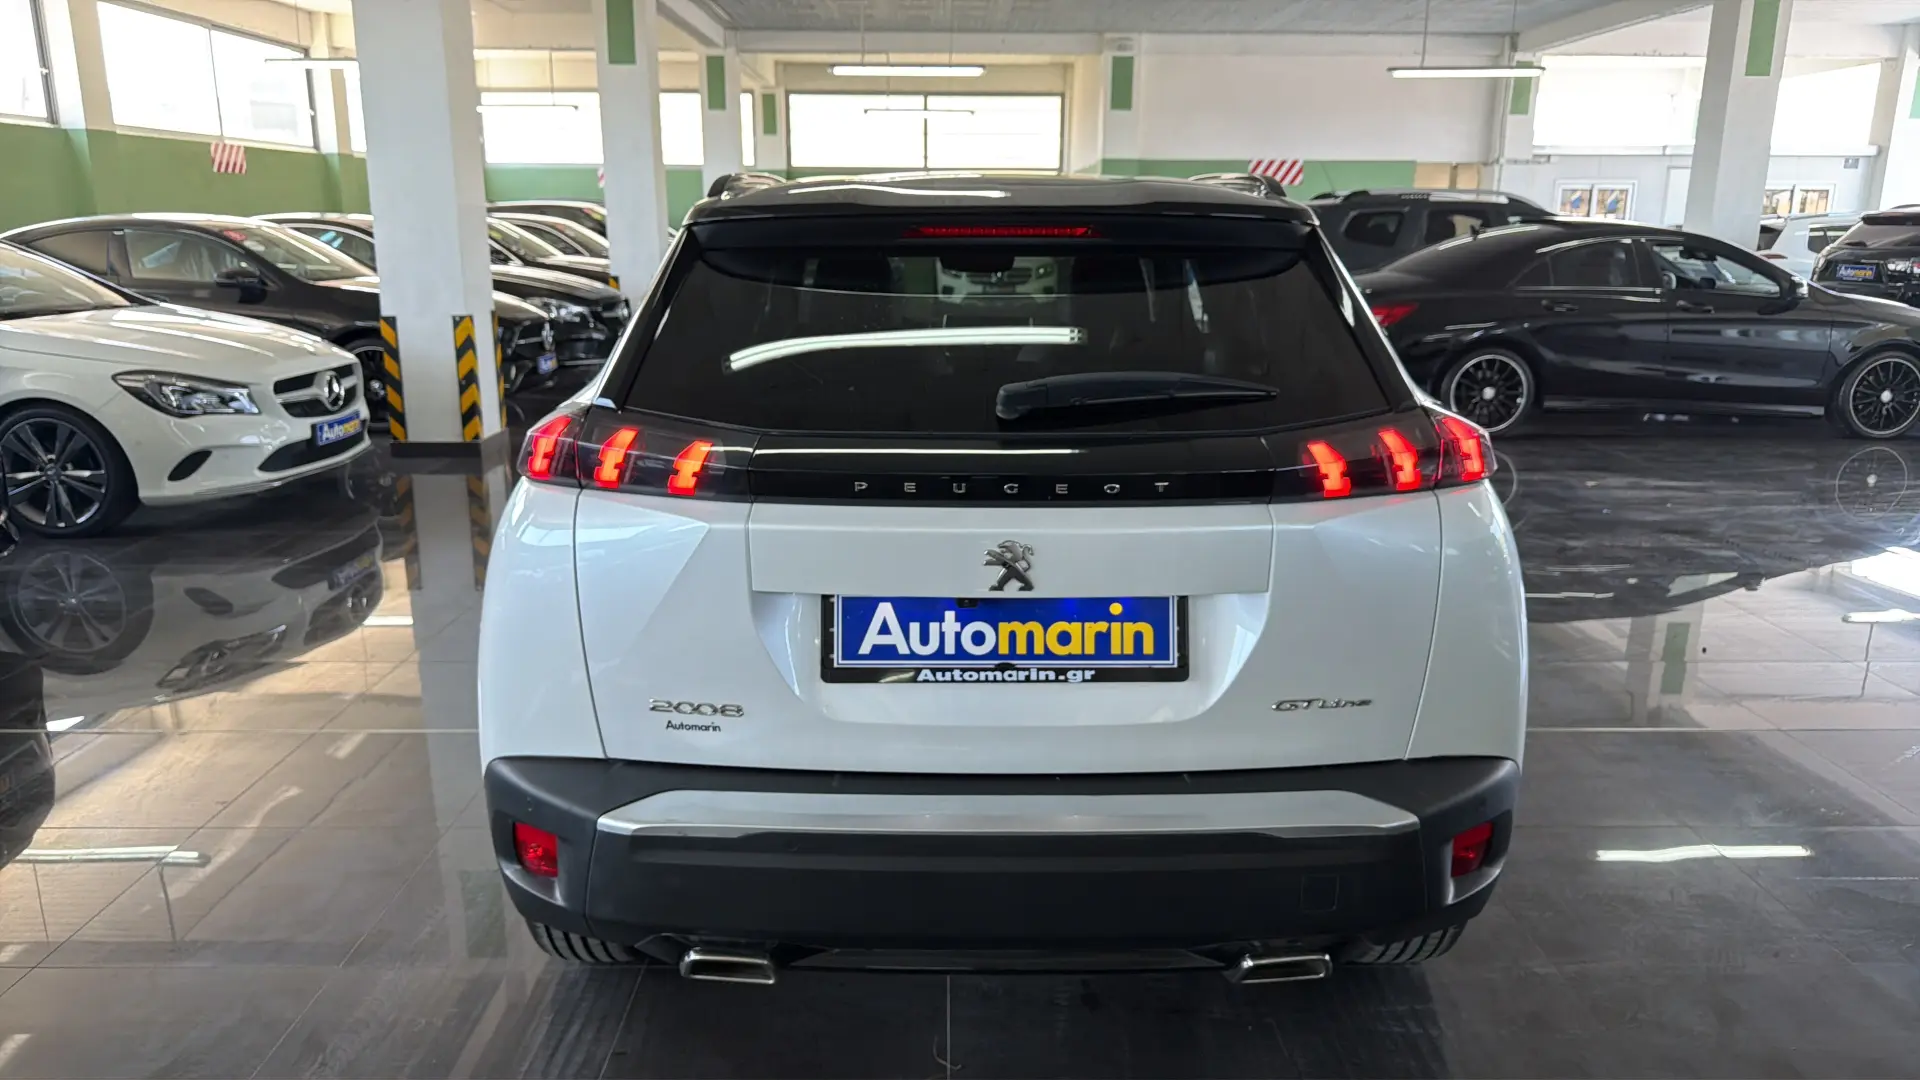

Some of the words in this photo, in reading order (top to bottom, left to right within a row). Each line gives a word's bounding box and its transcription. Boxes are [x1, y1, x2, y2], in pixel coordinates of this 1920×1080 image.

[854, 481, 1169, 494] PEUGEOT
[857, 601, 1154, 656] Automarin
[916, 668, 1096, 683] Automarin.gr
[649, 698, 744, 717] 2008
[666, 720, 721, 732] Automarin
